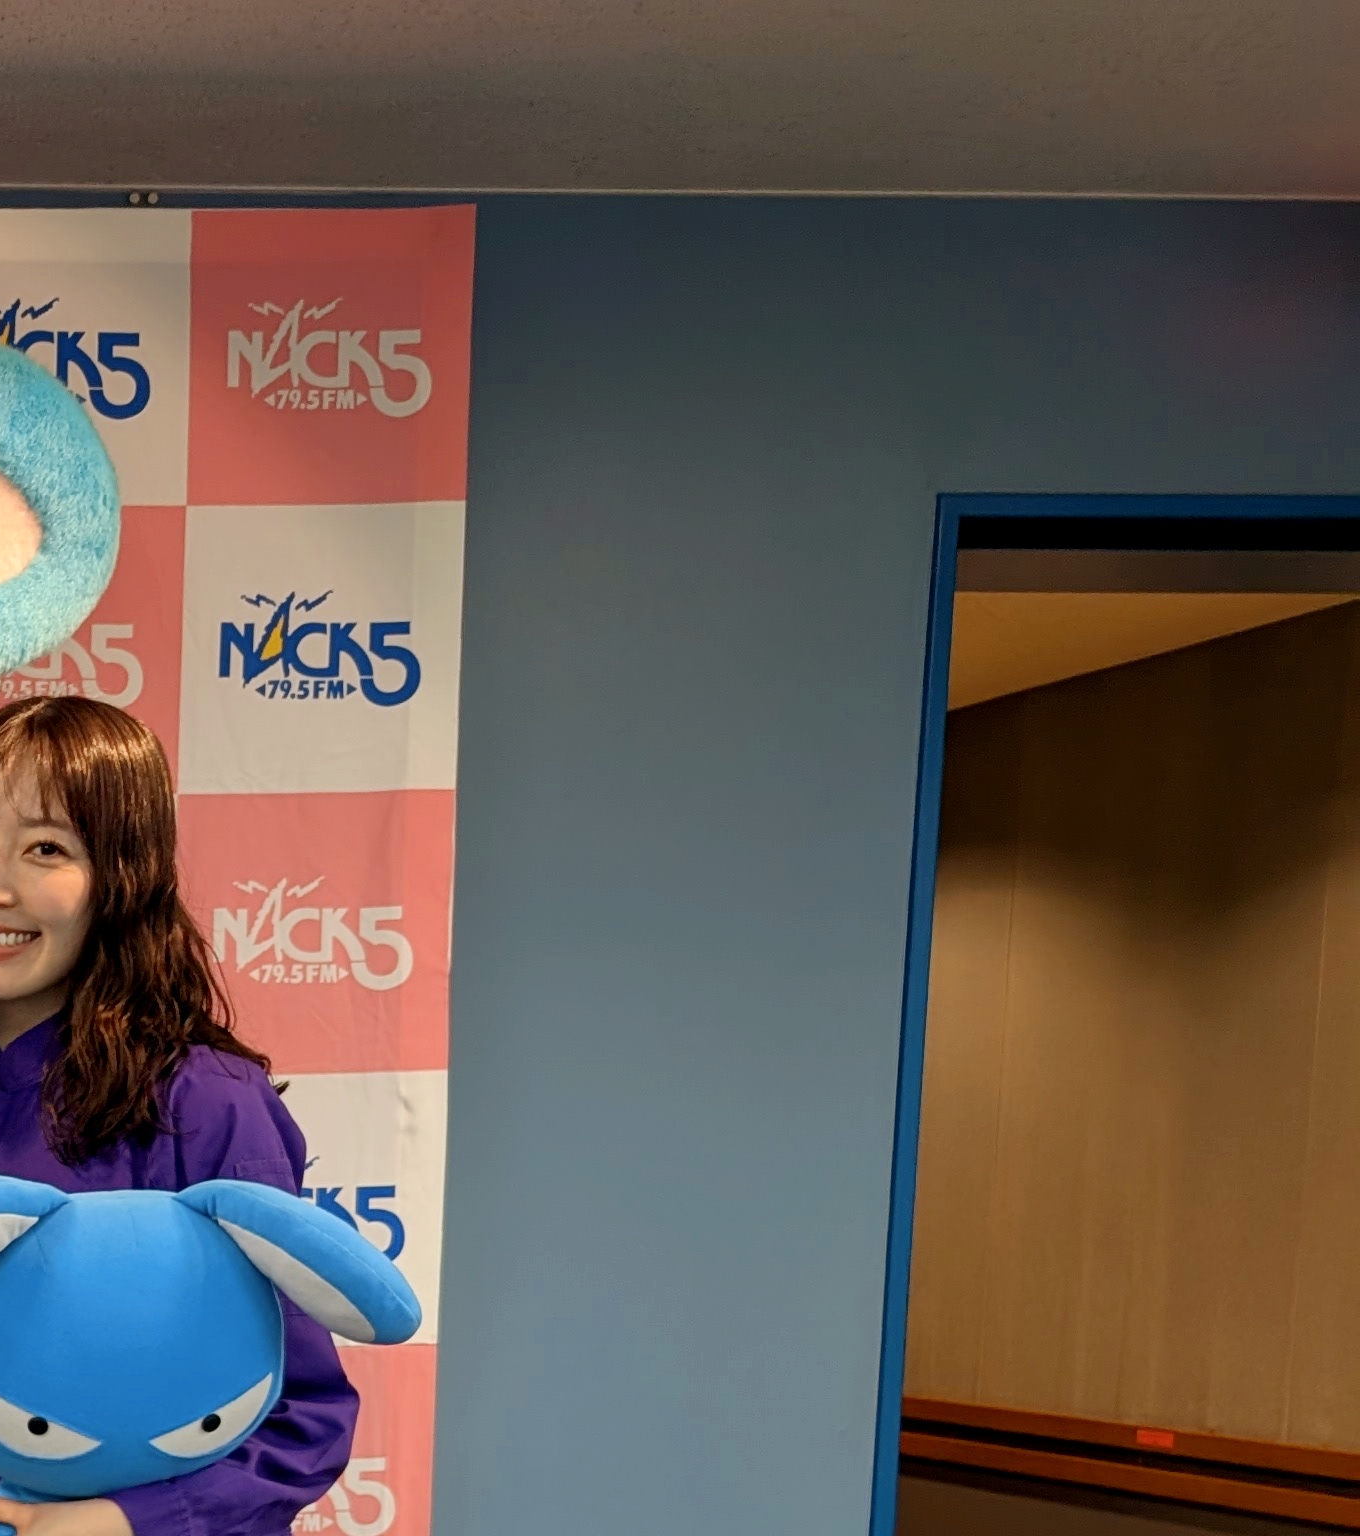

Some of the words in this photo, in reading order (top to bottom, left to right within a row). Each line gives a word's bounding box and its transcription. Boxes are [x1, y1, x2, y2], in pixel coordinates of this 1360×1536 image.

[228, 299, 432, 418] NACK5
[218, 591, 420, 707] NACK5
[213, 877, 413, 991] NACK5
